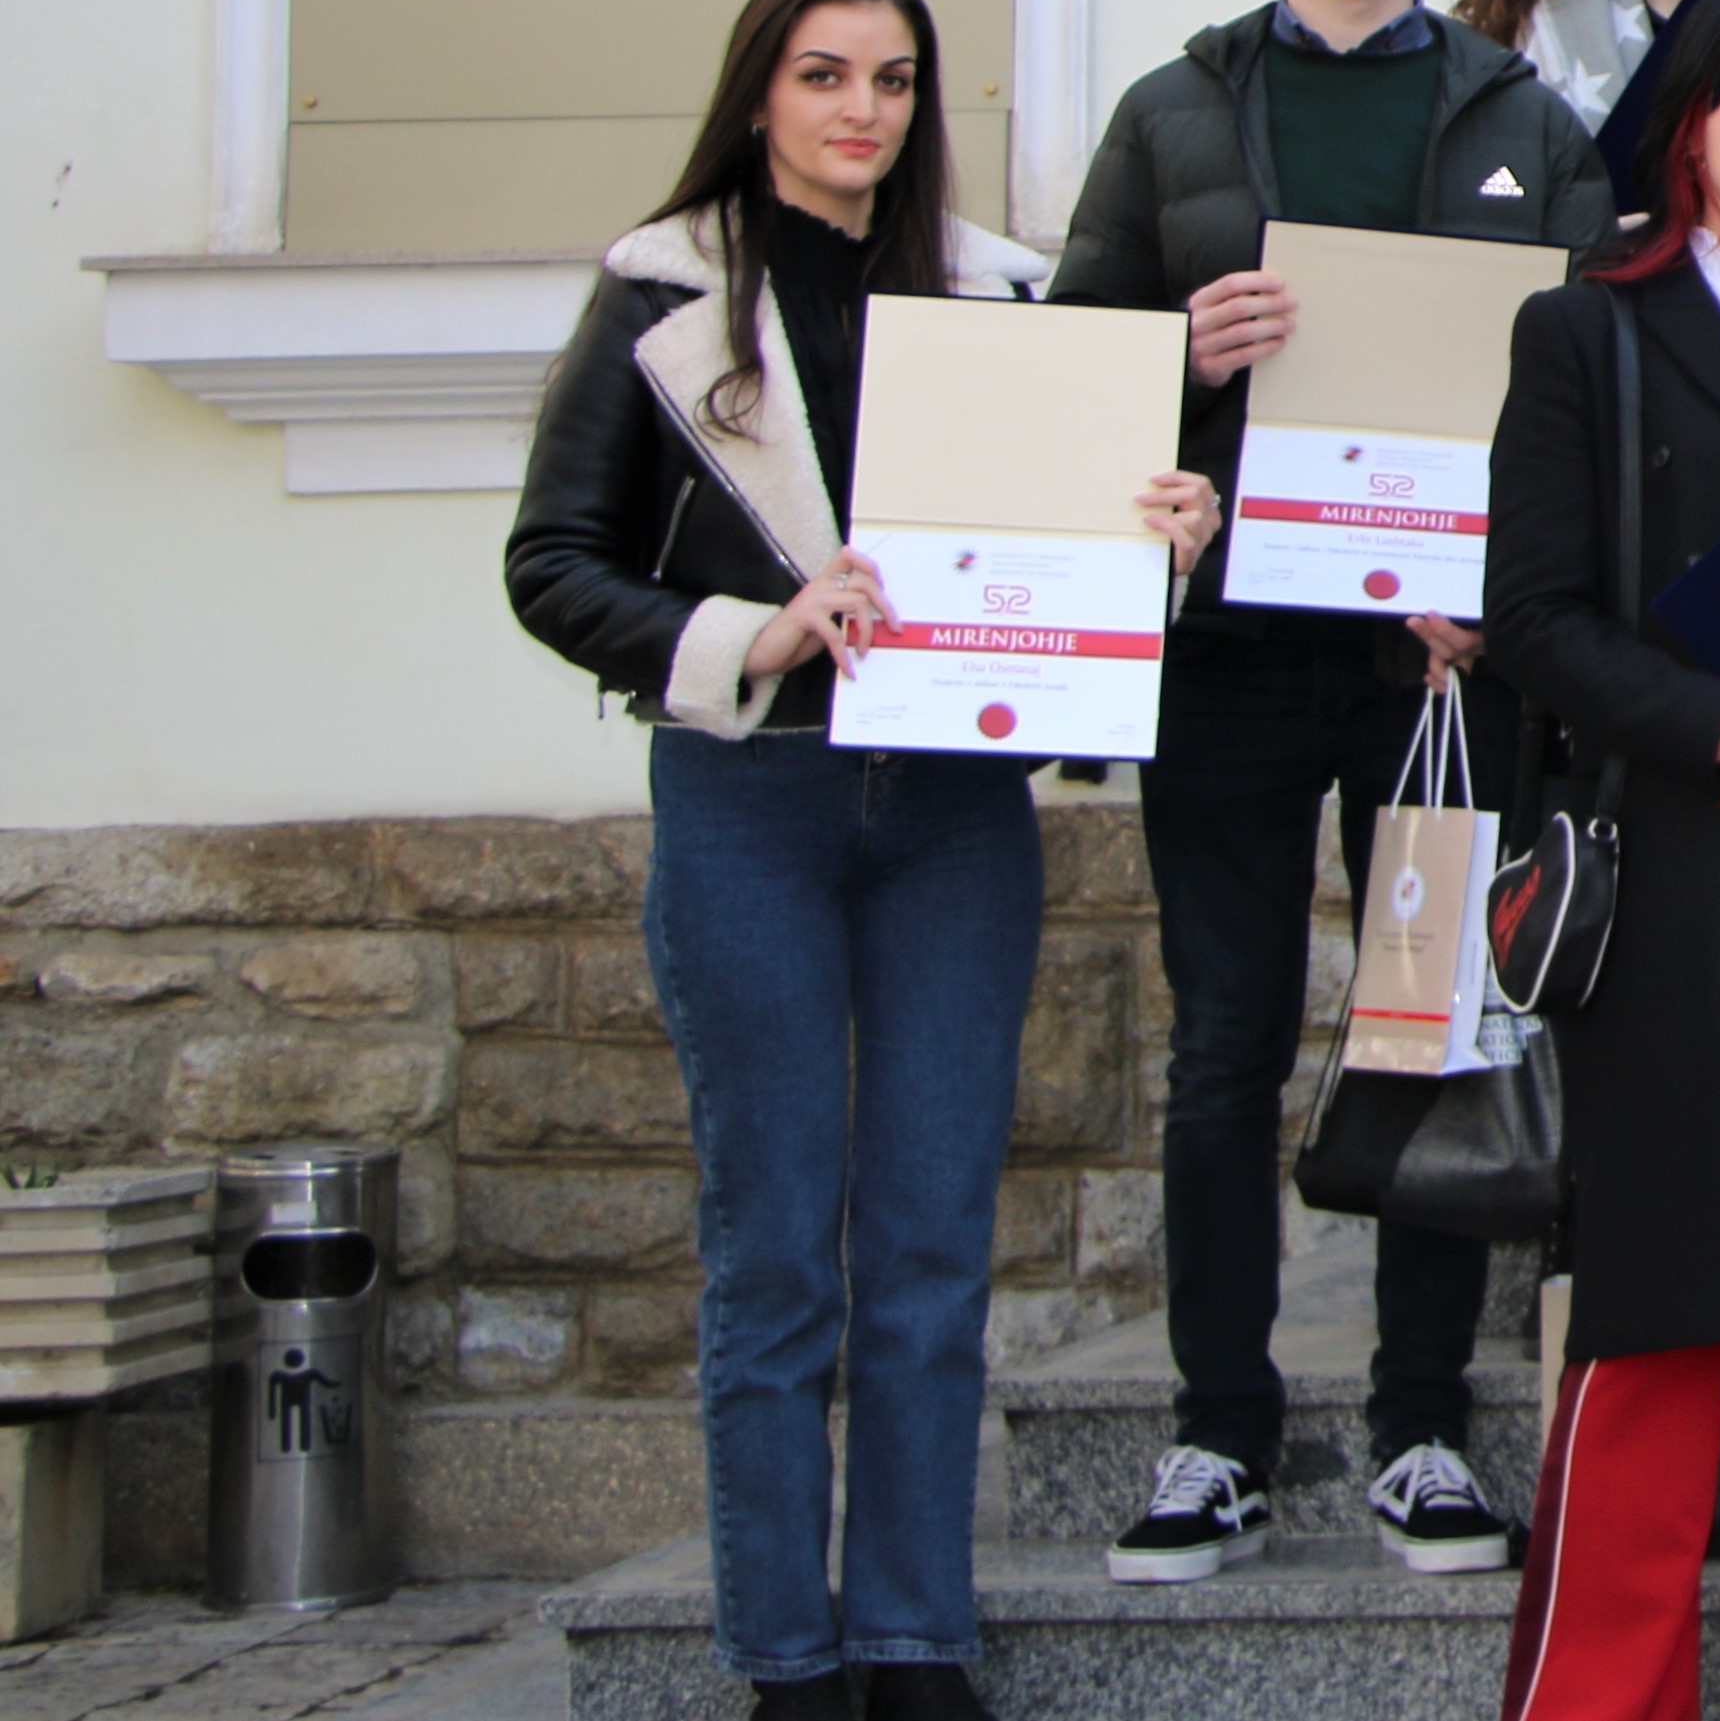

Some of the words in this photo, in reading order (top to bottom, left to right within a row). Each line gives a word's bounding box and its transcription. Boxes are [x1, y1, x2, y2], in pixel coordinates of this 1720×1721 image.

[1368, 473, 1415, 498] 52
[1319, 504, 1458, 530] MIRËNJOHJE
[982, 584, 1032, 615] 52
[930, 627, 1078, 654] MIRËNJOHJE
